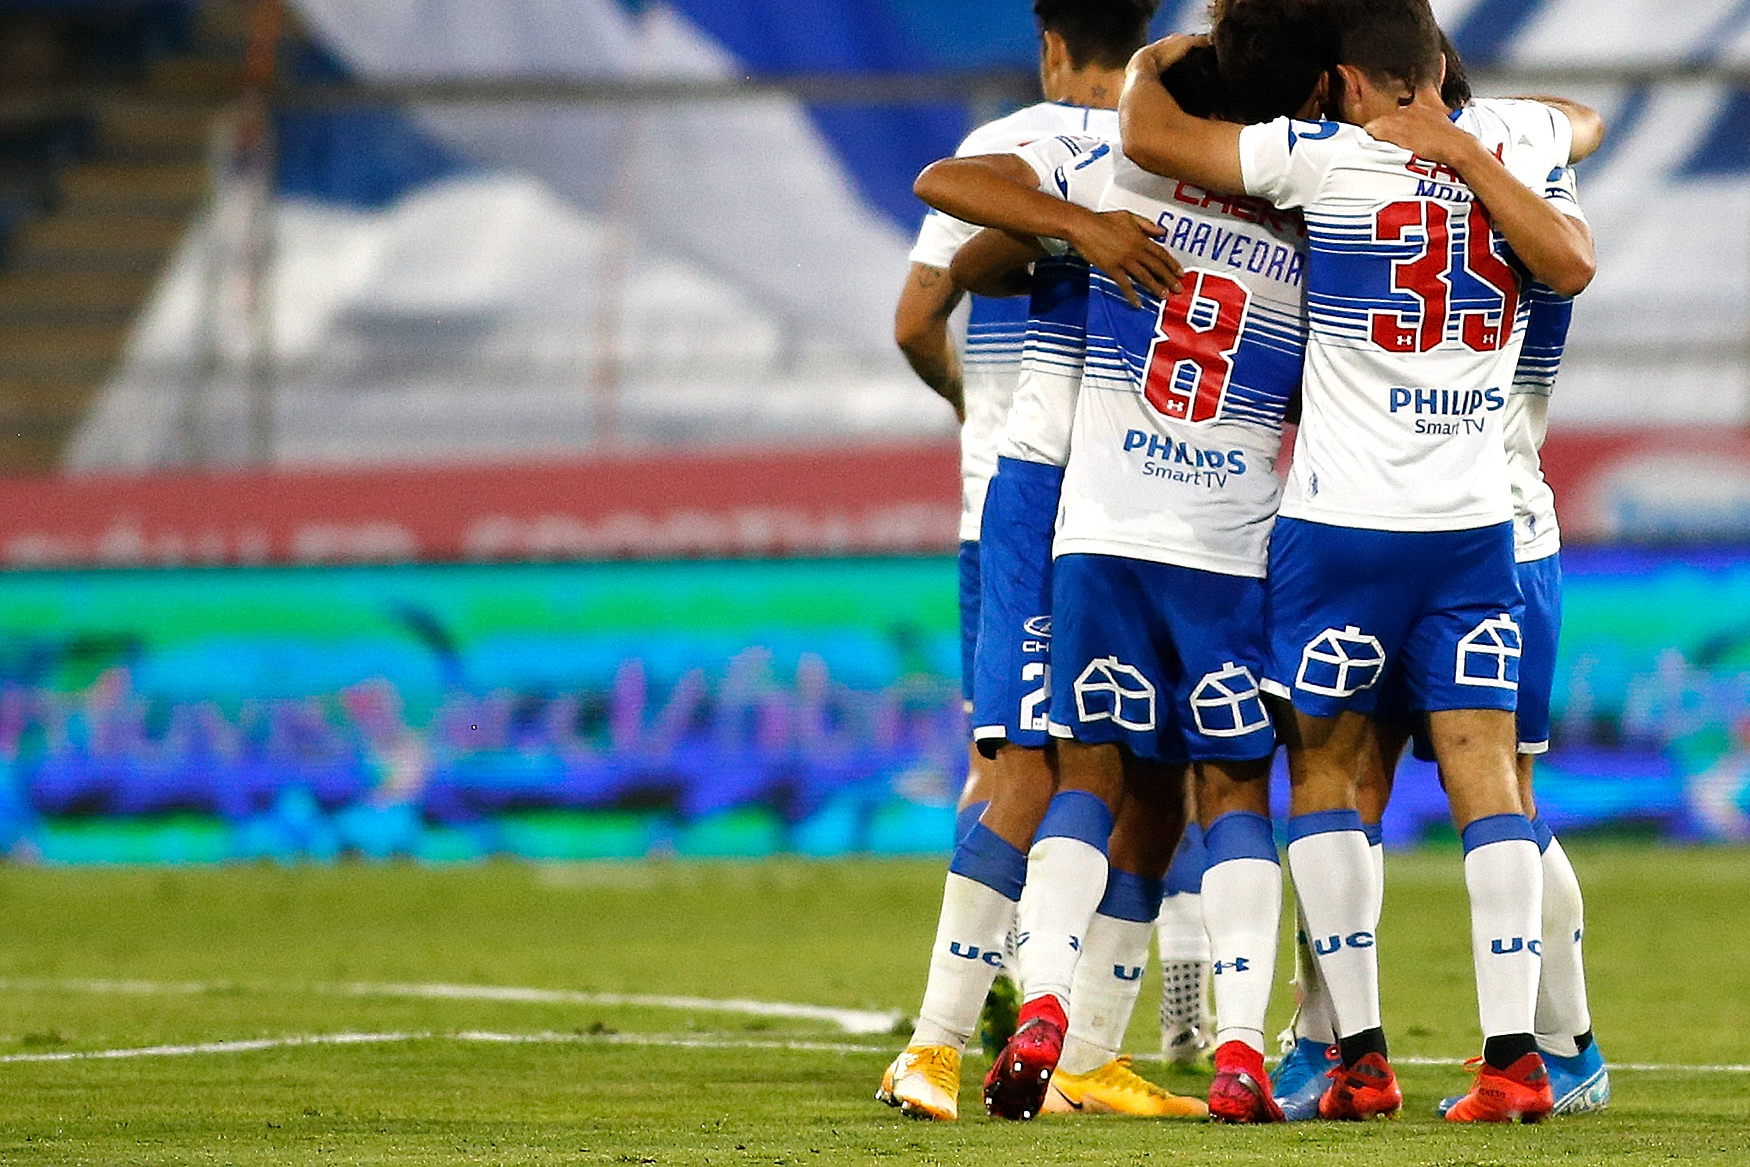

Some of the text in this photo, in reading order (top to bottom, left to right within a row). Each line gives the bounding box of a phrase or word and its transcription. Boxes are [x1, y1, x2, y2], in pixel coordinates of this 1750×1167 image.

[1371, 197, 1522, 354] 35
[1141, 266, 1252, 426] 8
[1390, 387, 1505, 416] PHILIPS
[1415, 417, 1485, 435] Smart TV
[1143, 461, 1228, 488] Smart TV
[950, 941, 1005, 968] UC
[1315, 931, 1373, 955] UC
[1114, 963, 1144, 981] U
